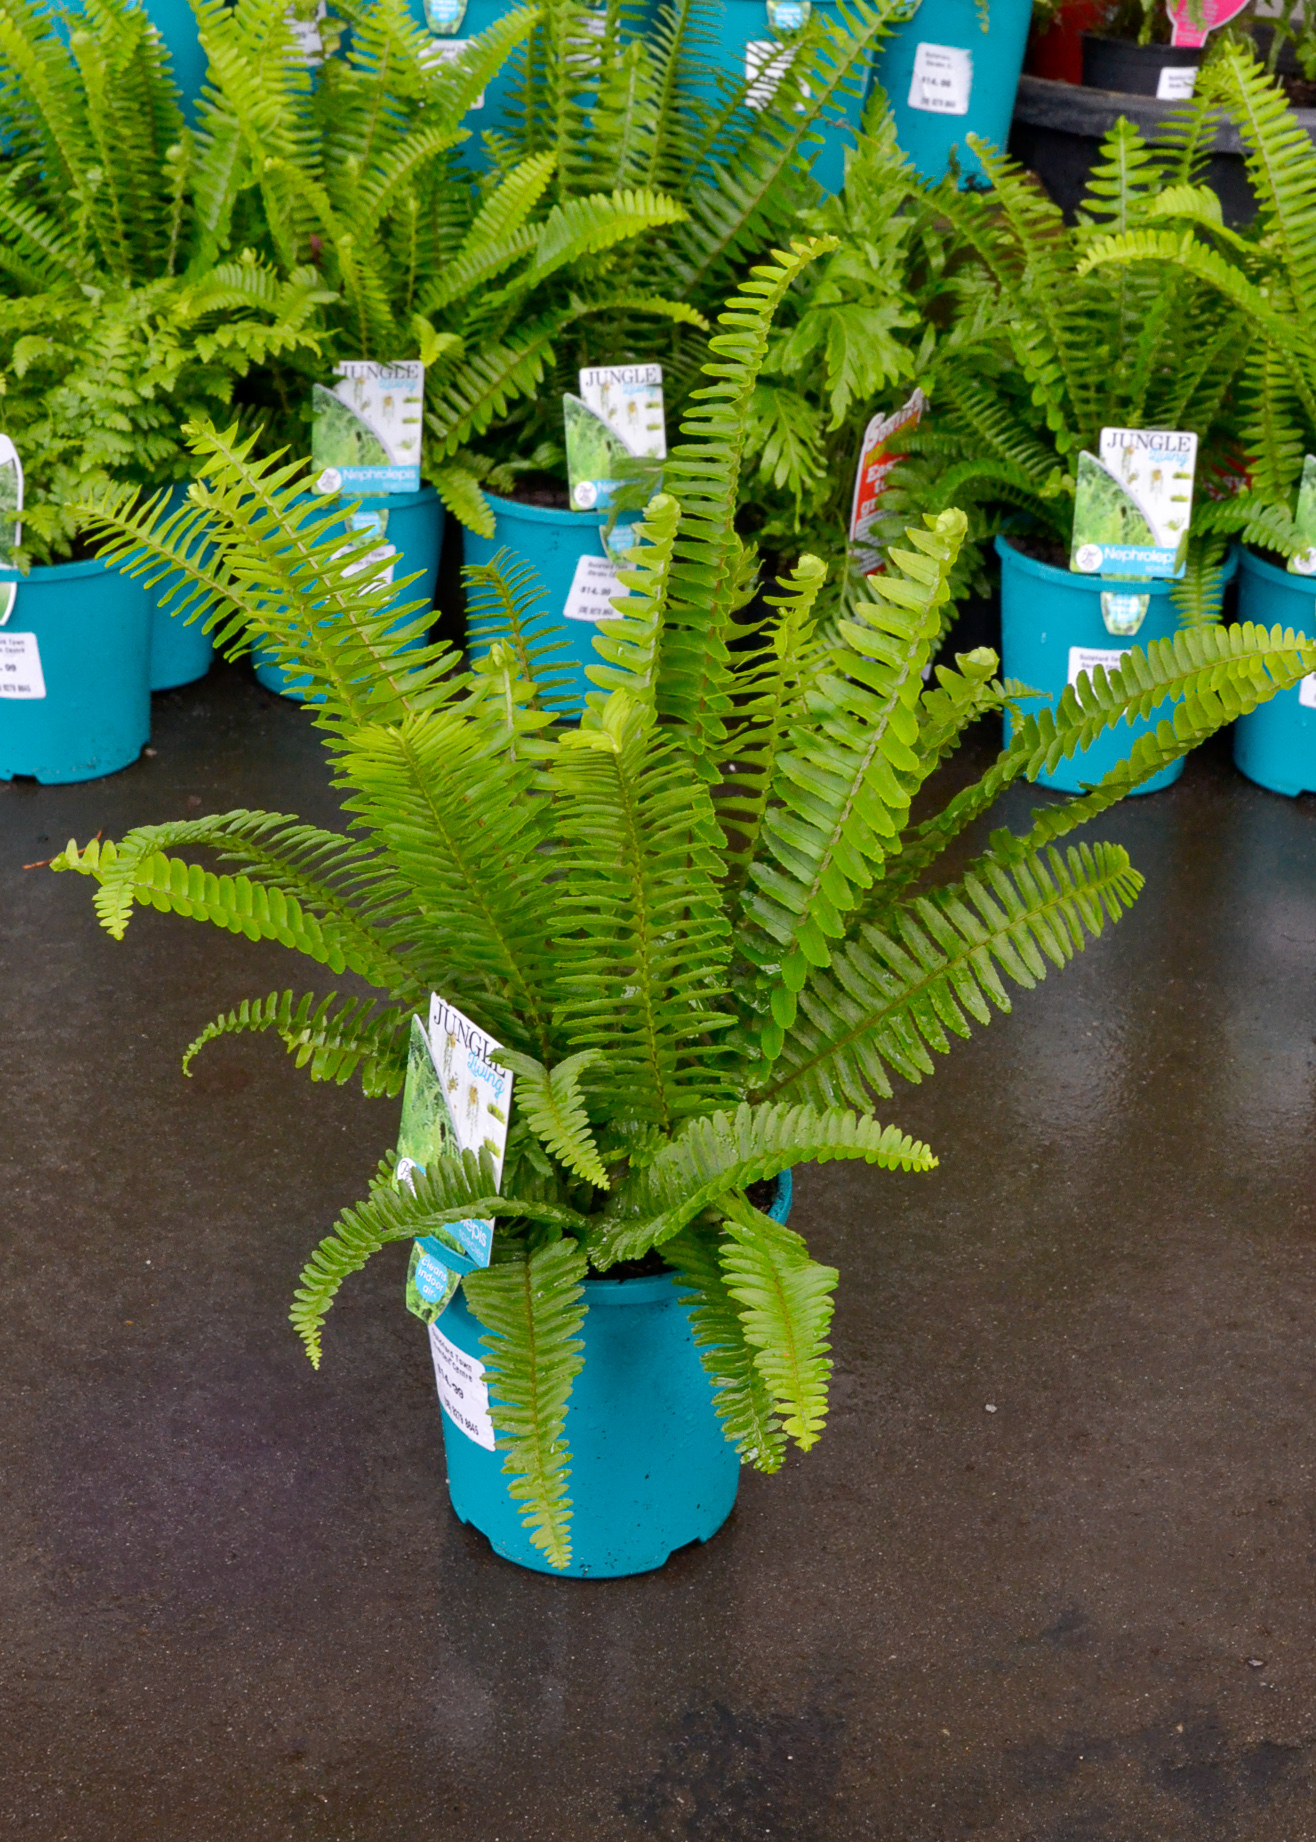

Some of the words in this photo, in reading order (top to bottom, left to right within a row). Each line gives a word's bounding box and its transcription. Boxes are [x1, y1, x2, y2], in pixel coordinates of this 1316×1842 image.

[585, 366, 657, 387] JUNGLE
[1106, 431, 1191, 452] JUNGLE
[467, 1051, 504, 1099] Living
[418, 1268, 444, 1292] indoor
[421, 1258, 447, 1282] cleans
